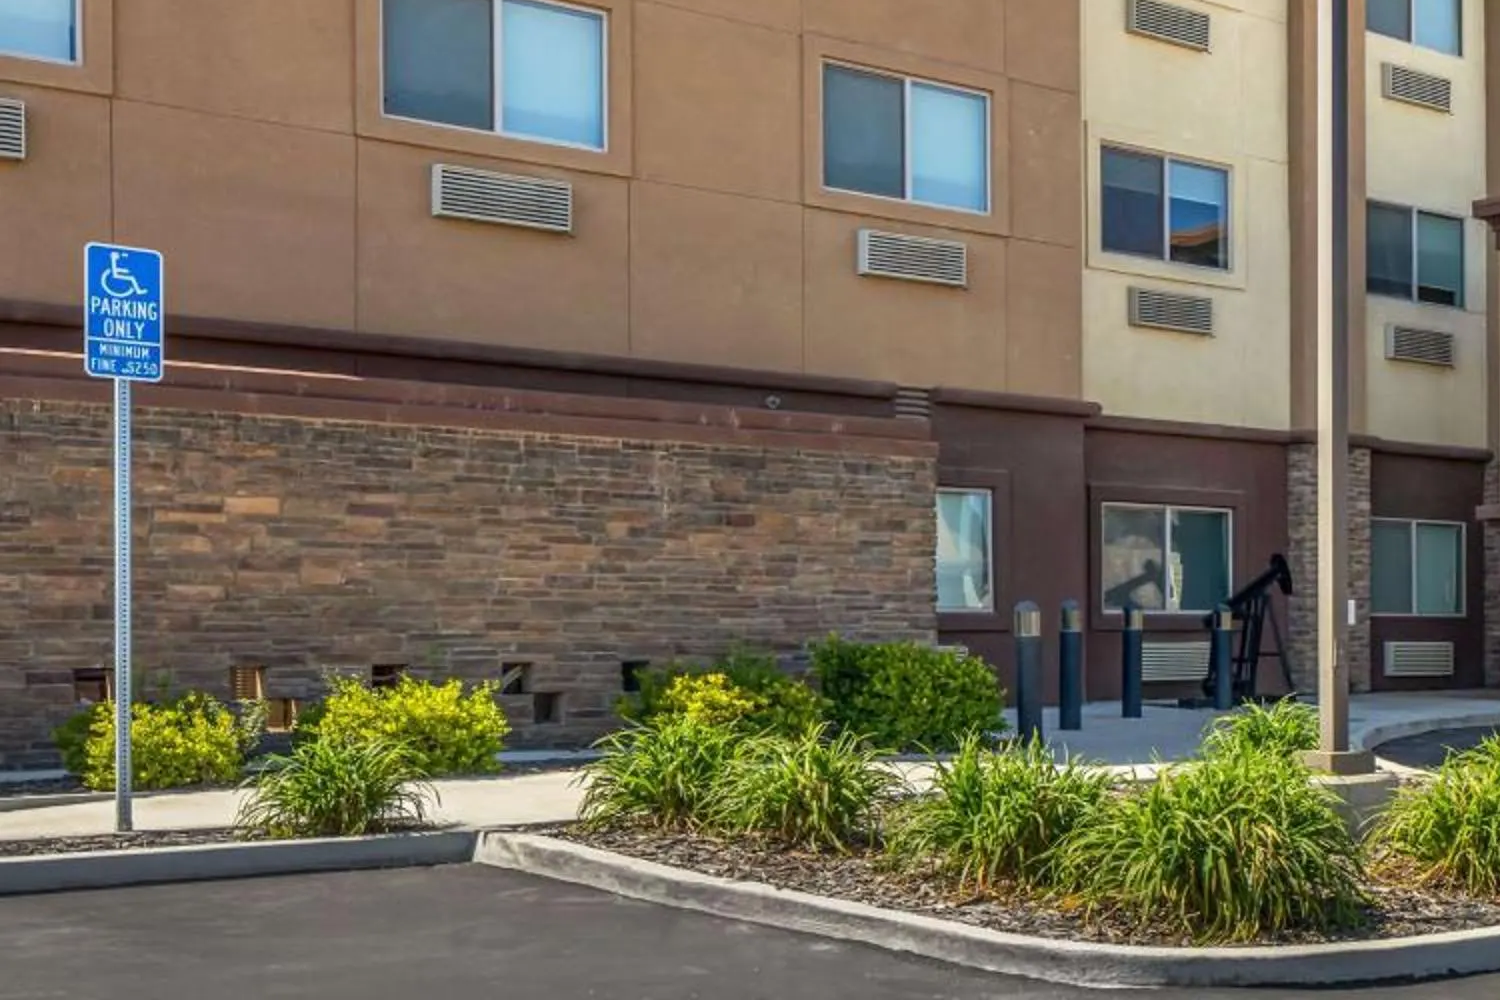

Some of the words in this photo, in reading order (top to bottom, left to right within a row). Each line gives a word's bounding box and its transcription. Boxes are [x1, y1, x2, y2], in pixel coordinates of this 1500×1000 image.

[91, 296, 157, 321] PARKING
[103, 318, 145, 340] ONLY
[99, 343, 150, 360] MINIMUM
[91, 357, 117, 374] FINE
